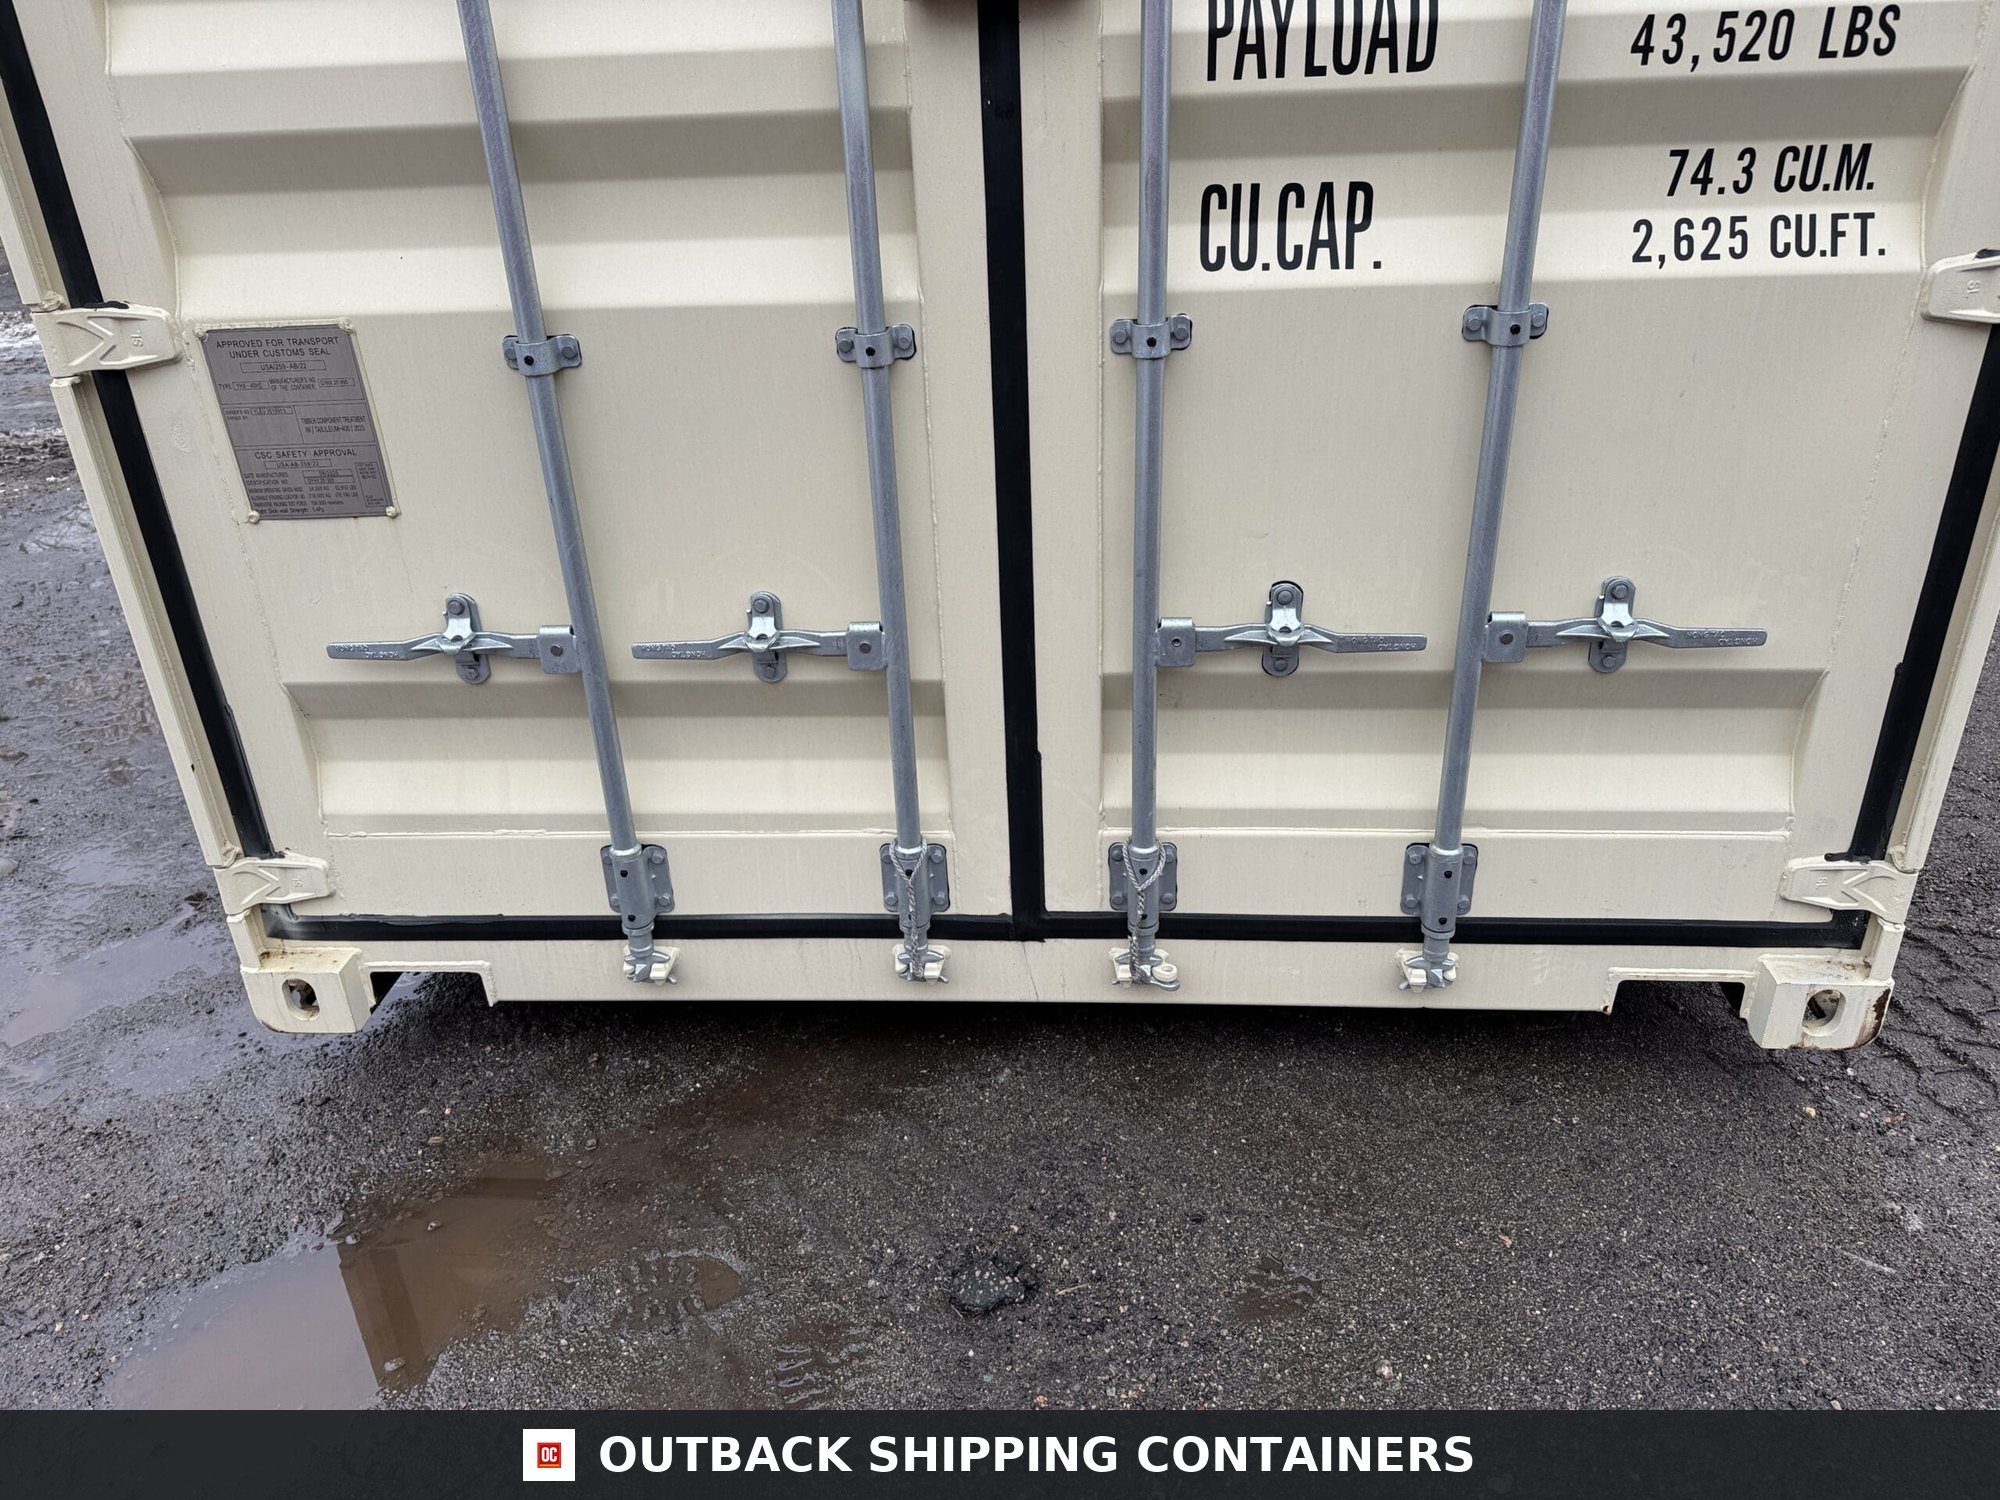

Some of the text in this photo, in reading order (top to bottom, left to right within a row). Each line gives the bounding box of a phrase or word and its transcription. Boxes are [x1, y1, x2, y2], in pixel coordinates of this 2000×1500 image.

[1207, 0, 1438, 81] PAYLOAD
[1631, 5, 1900, 72] 43,520 LBS
[1667, 143, 1874, 196] 74.3 CU.M.
[1200, 181, 1381, 271] CU.CAP.
[1633, 213, 1885, 269] 2,625 CU.FT.
[216, 336, 339, 349] APPROVED FOR TRANSPORT
[229, 347, 331, 359] UNDER CUSTOMS SEAL
[255, 448, 357, 460] CSC SAFETY APPROVAL
